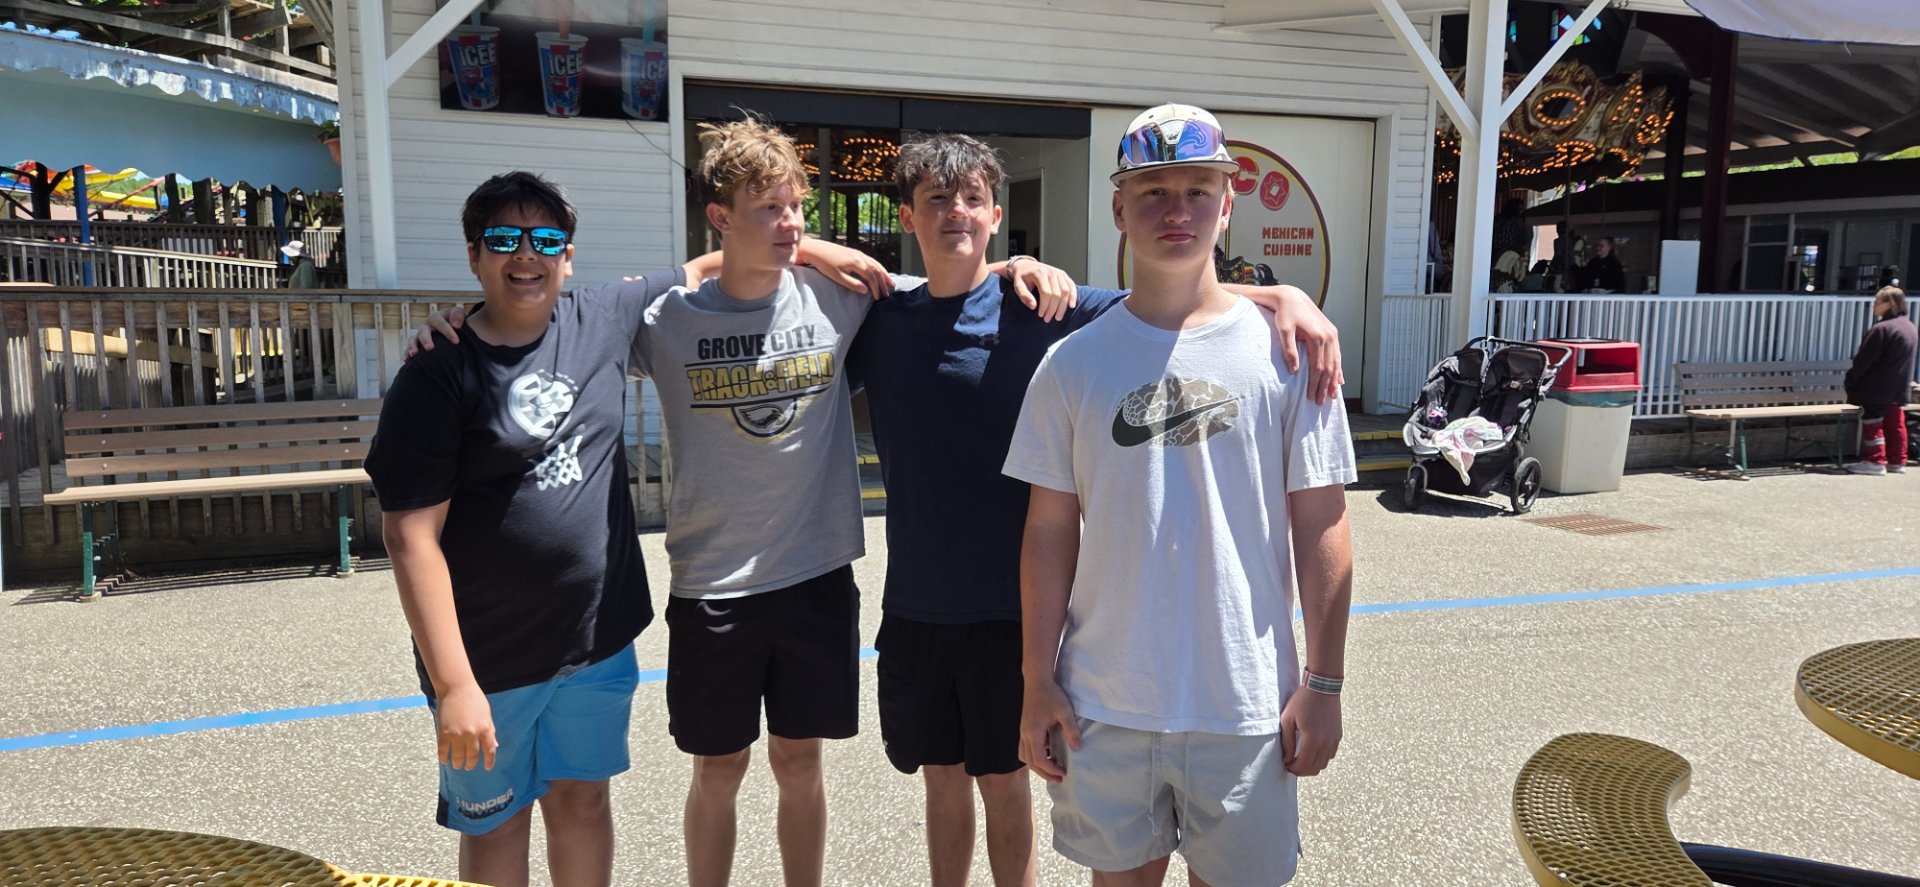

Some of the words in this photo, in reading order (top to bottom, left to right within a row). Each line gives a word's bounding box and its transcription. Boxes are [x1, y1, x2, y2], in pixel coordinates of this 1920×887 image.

[458, 43, 497, 67] ICEE
[550, 53, 582, 75] ICEE
[1262, 227, 1314, 239] MEXICAN
[1263, 243, 1312, 256] CUISINE
[697, 333, 767, 361] GROVE
[770, 324, 816, 352] CITY
